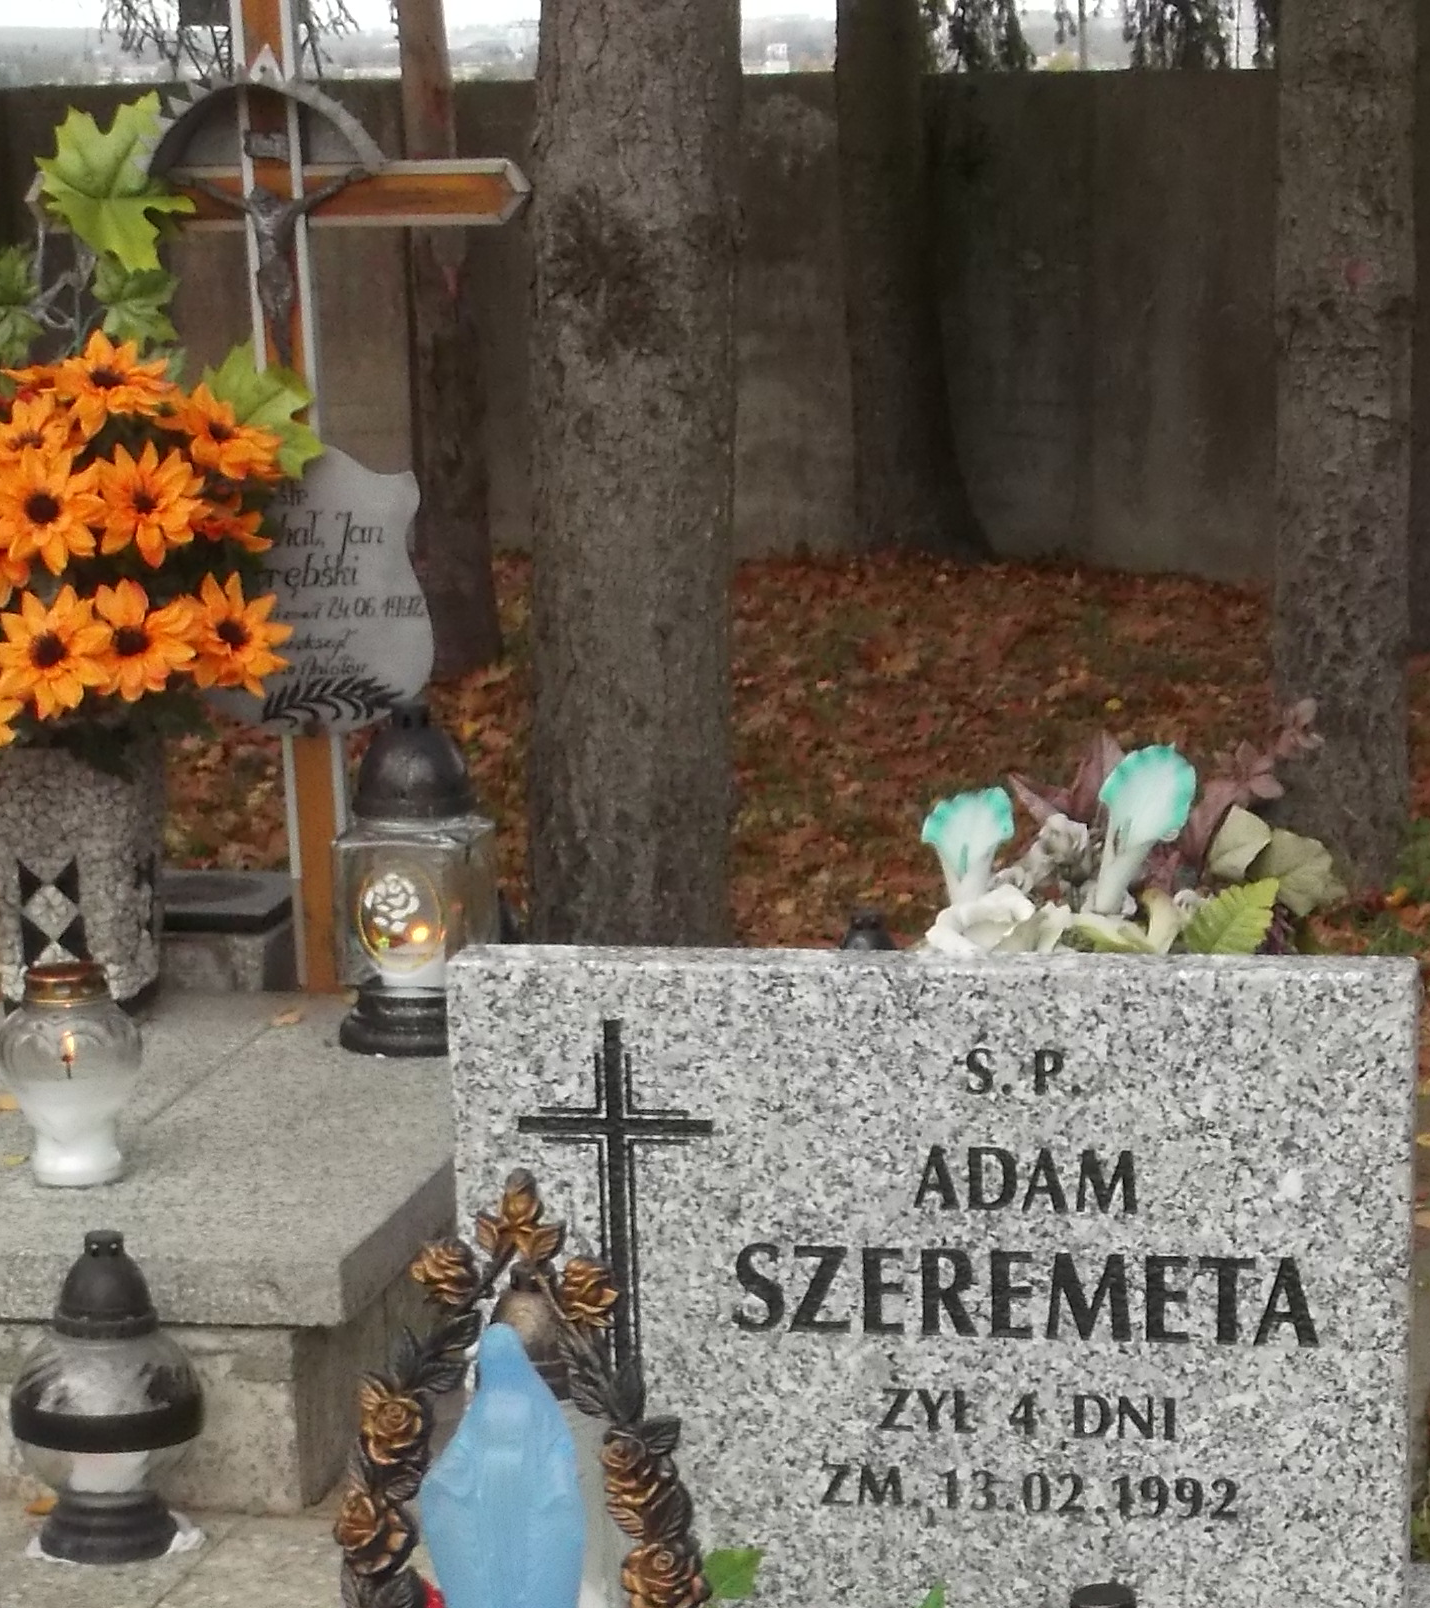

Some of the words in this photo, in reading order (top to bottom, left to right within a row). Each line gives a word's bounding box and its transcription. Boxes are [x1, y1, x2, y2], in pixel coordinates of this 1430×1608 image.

[335, 511, 384, 562] Jan
[913, 1145, 1138, 1214] ADAM
[732, 1242, 1320, 1347] SZEREMETA
[1008, 1390, 1039, 1436] 4
[1072, 1393, 1177, 1442] DNI
[939, 1468, 1240, 1520] 13.02.1992
